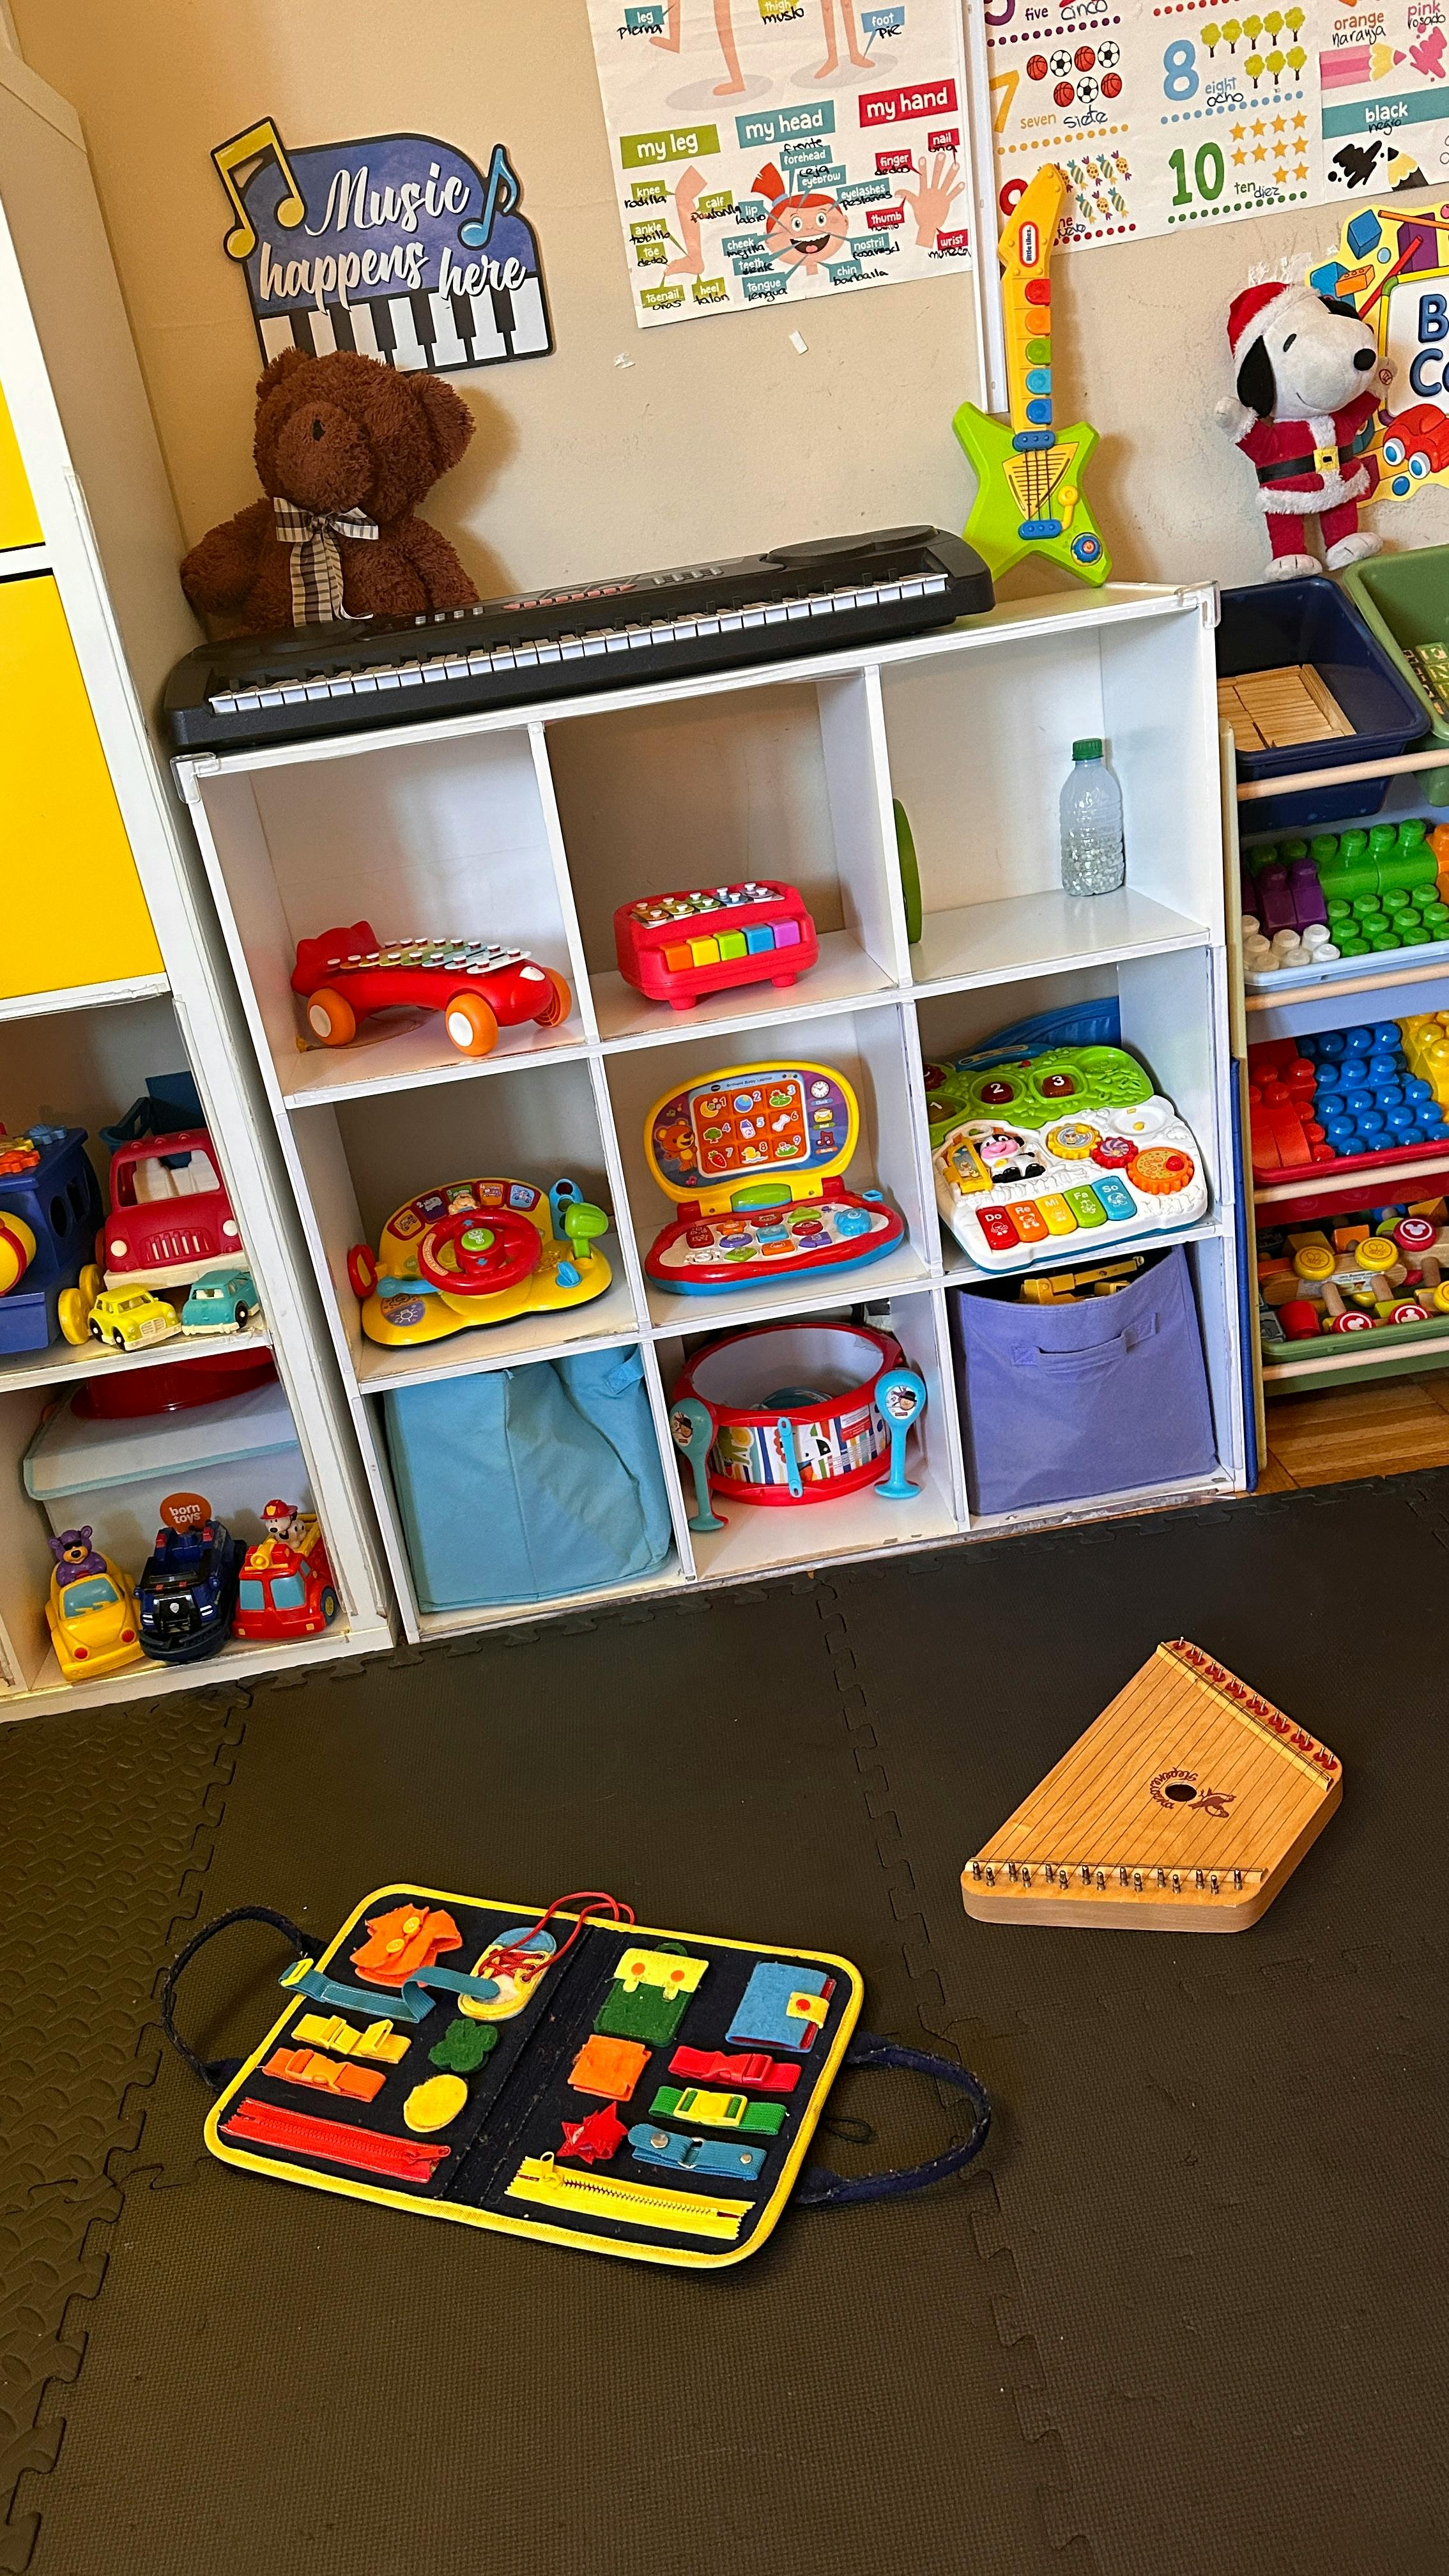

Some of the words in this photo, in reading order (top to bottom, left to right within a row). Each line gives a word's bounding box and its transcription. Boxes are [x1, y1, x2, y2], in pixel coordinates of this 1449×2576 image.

[762, 6, 804, 25] muslo
[1025, 8, 1048, 21] five
[1061, 0, 1108, 21] cinco
[1407, 1, 1441, 18] pink
[637, 12, 654, 24] leg
[872, 12, 894, 27] foot
[1334, 12, 1384, 31] orange
[1407, 12, 1446, 29] rosado
[616, 24, 663, 40] pierna
[875, 24, 902, 39] pie
[1332, 26, 1386, 47] naranja
[1163, 39, 1200, 102] 8
[1205, 77, 1237, 95] eight
[866, 99, 896, 119] my
[900, 87, 948, 111] hand
[989, 70, 1020, 134] 7
[1207, 92, 1244, 107] ocho
[1063, 105, 1108, 128] siete
[1365, 102, 1408, 123] black
[746, 123, 776, 140] my
[779, 110, 823, 130] head
[1020, 114, 1057, 129] seven
[1368, 119, 1402, 135] negro
[933, 132, 952, 145] nail
[637, 142, 666, 160] my
[670, 134, 699, 155] leg
[784, 138, 823, 155] frente
[784, 150, 825, 165] forehead
[880, 154, 909, 168] finger
[799, 165, 829, 178] ceja
[1168, 142, 1225, 206] 10
[802, 172, 841, 188] eyebrow
[637, 186, 660, 196] knee
[841, 183, 885, 200] eyelashes
[1234, 181, 1256, 195] ten
[1254, 185, 1280, 198] diez
[304, 162, 471, 236] Music
[705, 196, 724, 208] calf
[745, 205, 757, 217] lip
[871, 211, 901, 224] thumb
[635, 223, 662, 235] ankle
[727, 238, 755, 250] cheek
[854, 236, 885, 250] nostril
[940, 234, 963, 247] wrist
[644, 247, 659, 257] toe
[738, 258, 764, 269] teeth
[836, 264, 857, 277] chin
[259, 241, 430, 316] happens
[438, 246, 526, 300] here
[700, 282, 719, 295] heel
[746, 279, 781, 293] tongue
[646, 290, 679, 303] toenail
[1409, 348, 1449, 397] C
[1052, 1075, 1064, 1086] 3
[753, 1091, 762, 1101] 2
[787, 1085, 795, 1095] 3
[990, 1084, 1004, 1094] 2
[719, 1096, 726, 1107] 1
[756, 1117, 765, 1127] 5
[791, 1111, 799, 1121] 6
[722, 1123, 731, 1132] 4
[759, 1142, 767, 1152] 8
[793, 1135, 801, 1145] 9
[726, 1147, 733, 1157] 7
[985, 1213, 1002, 1222] Do
[169, 1505, 200, 1516] born
[174, 1512, 201, 1523] toys
